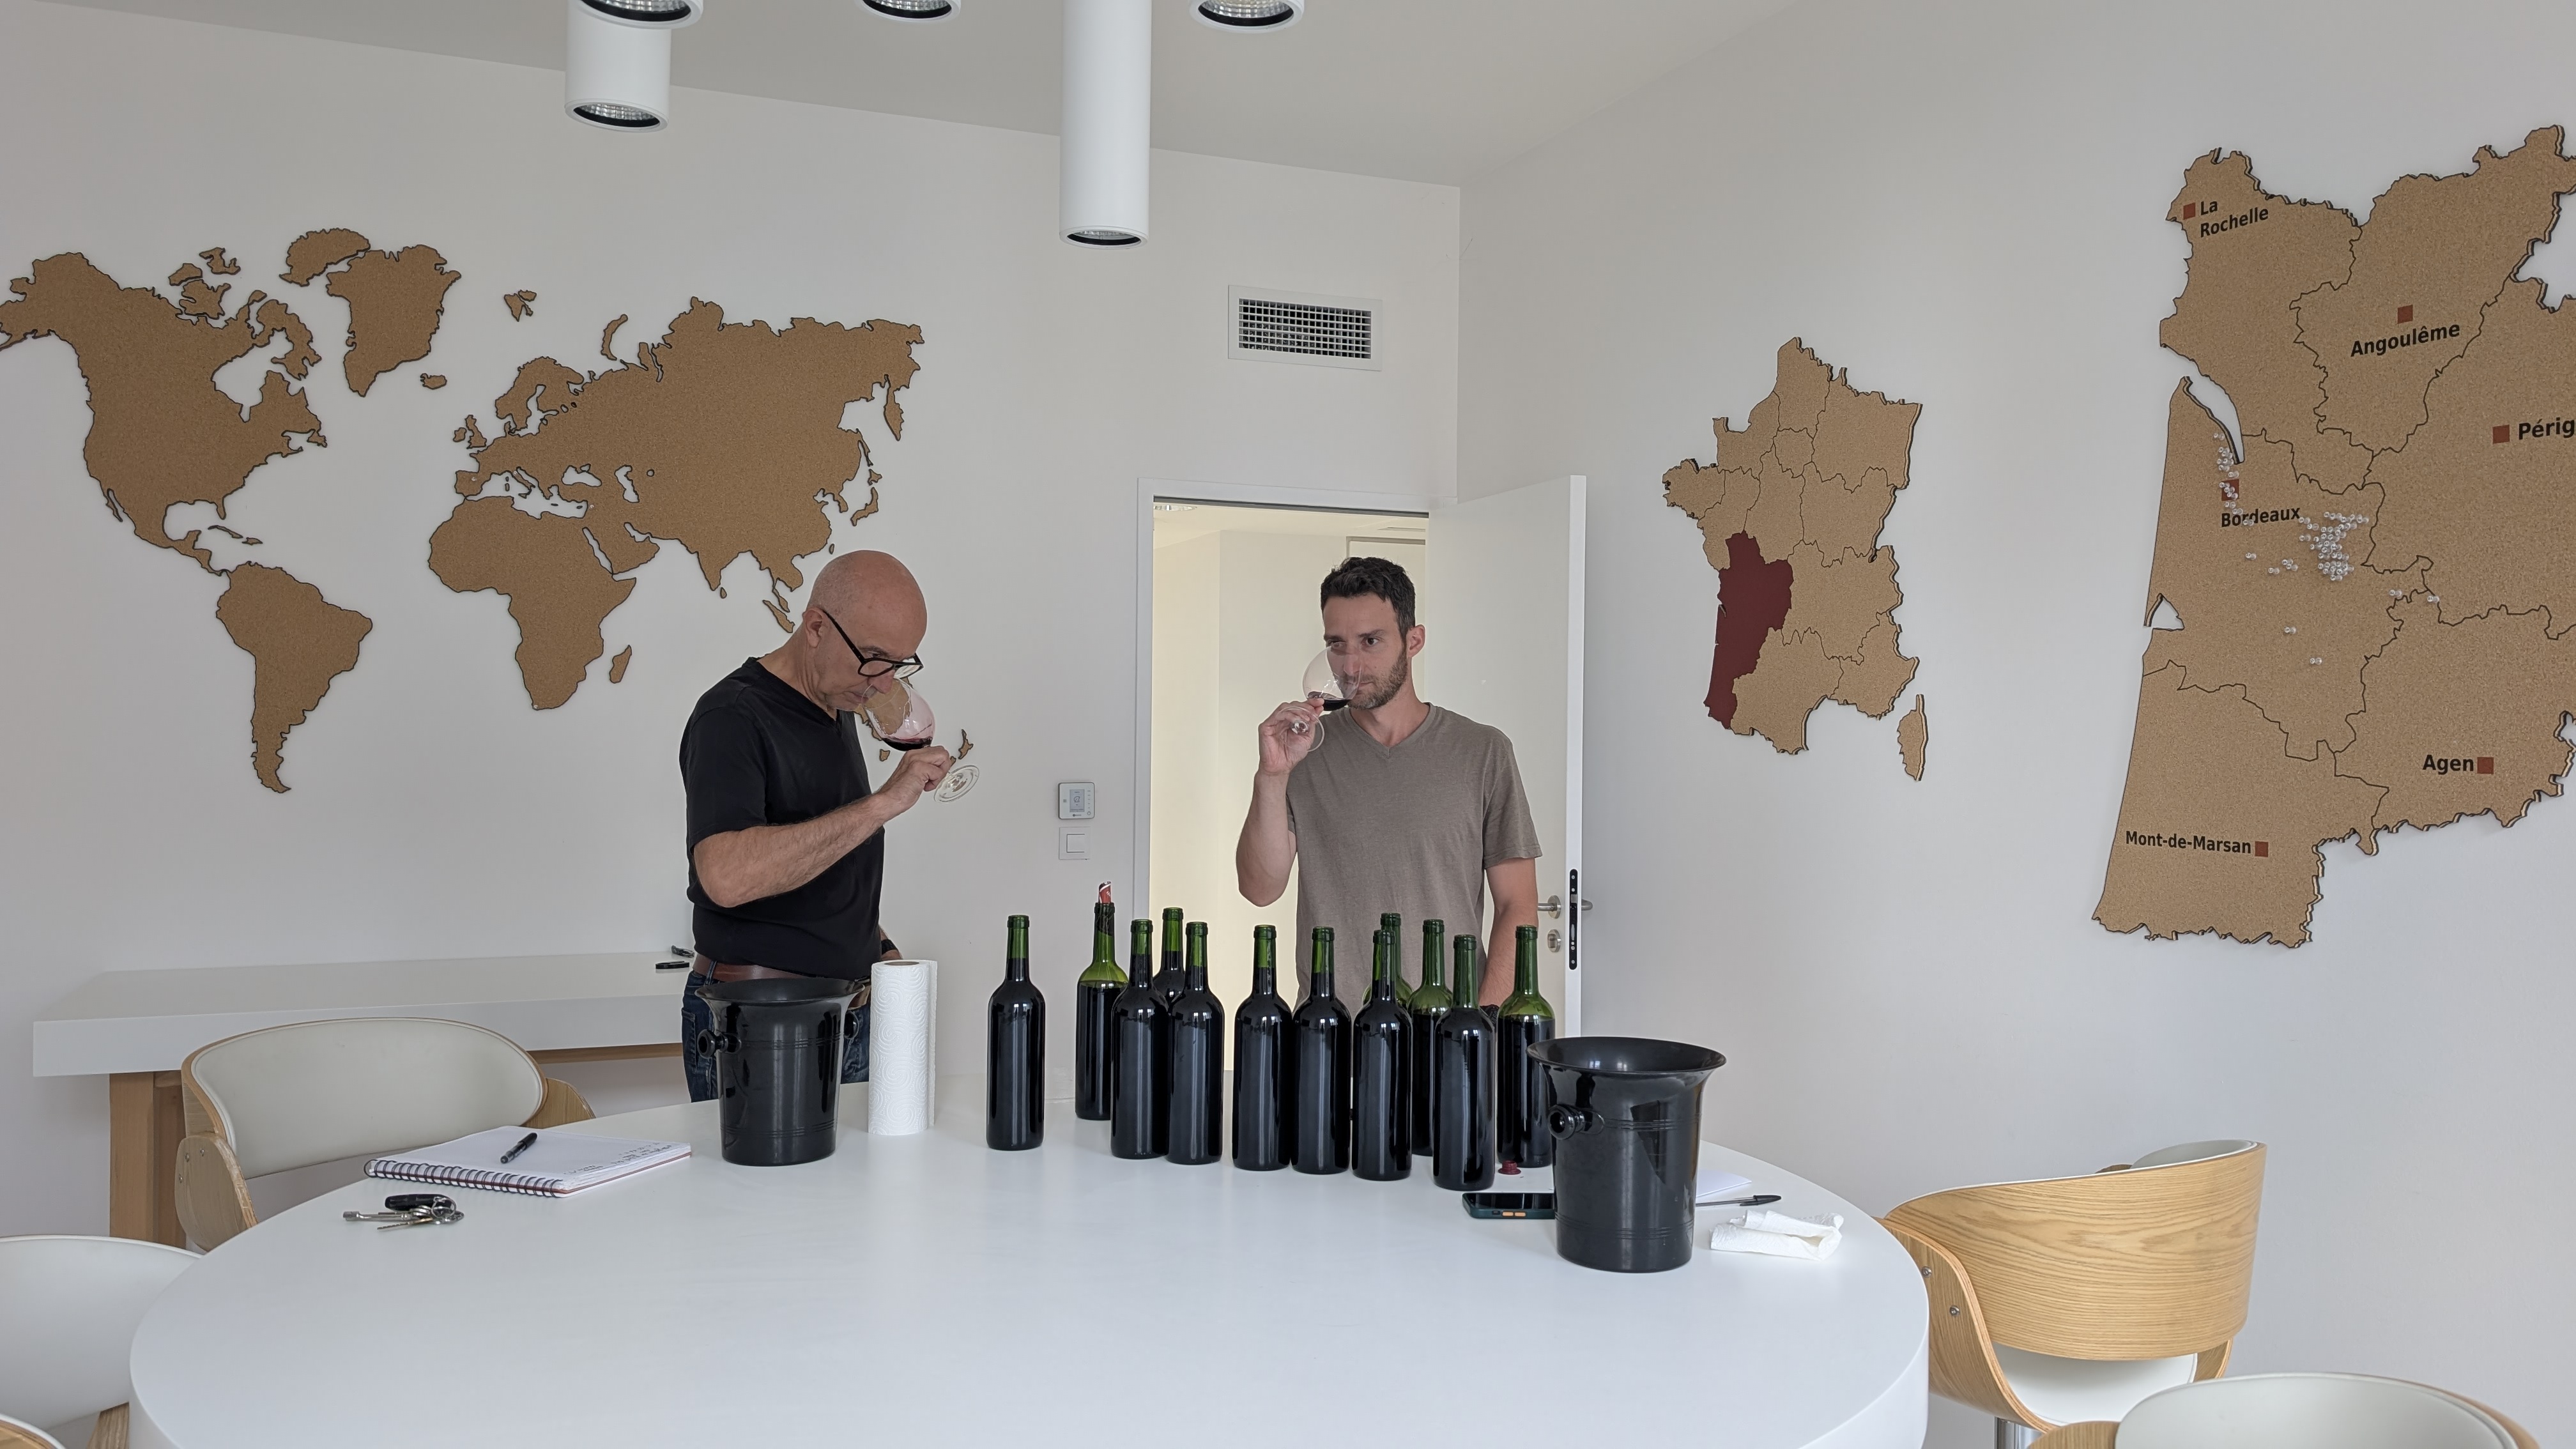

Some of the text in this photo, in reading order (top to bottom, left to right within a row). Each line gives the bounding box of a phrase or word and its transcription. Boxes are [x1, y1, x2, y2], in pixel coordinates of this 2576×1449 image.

[2200, 201, 2218, 215] La
[2200, 208, 2268, 238] Rochelle
[2350, 324, 2460, 357] Angoulême
[2221, 508, 2300, 528] Bordeaux
[2422, 755, 2474, 775] Agen
[2126, 831, 2251, 854] Mont-de-Marsan
